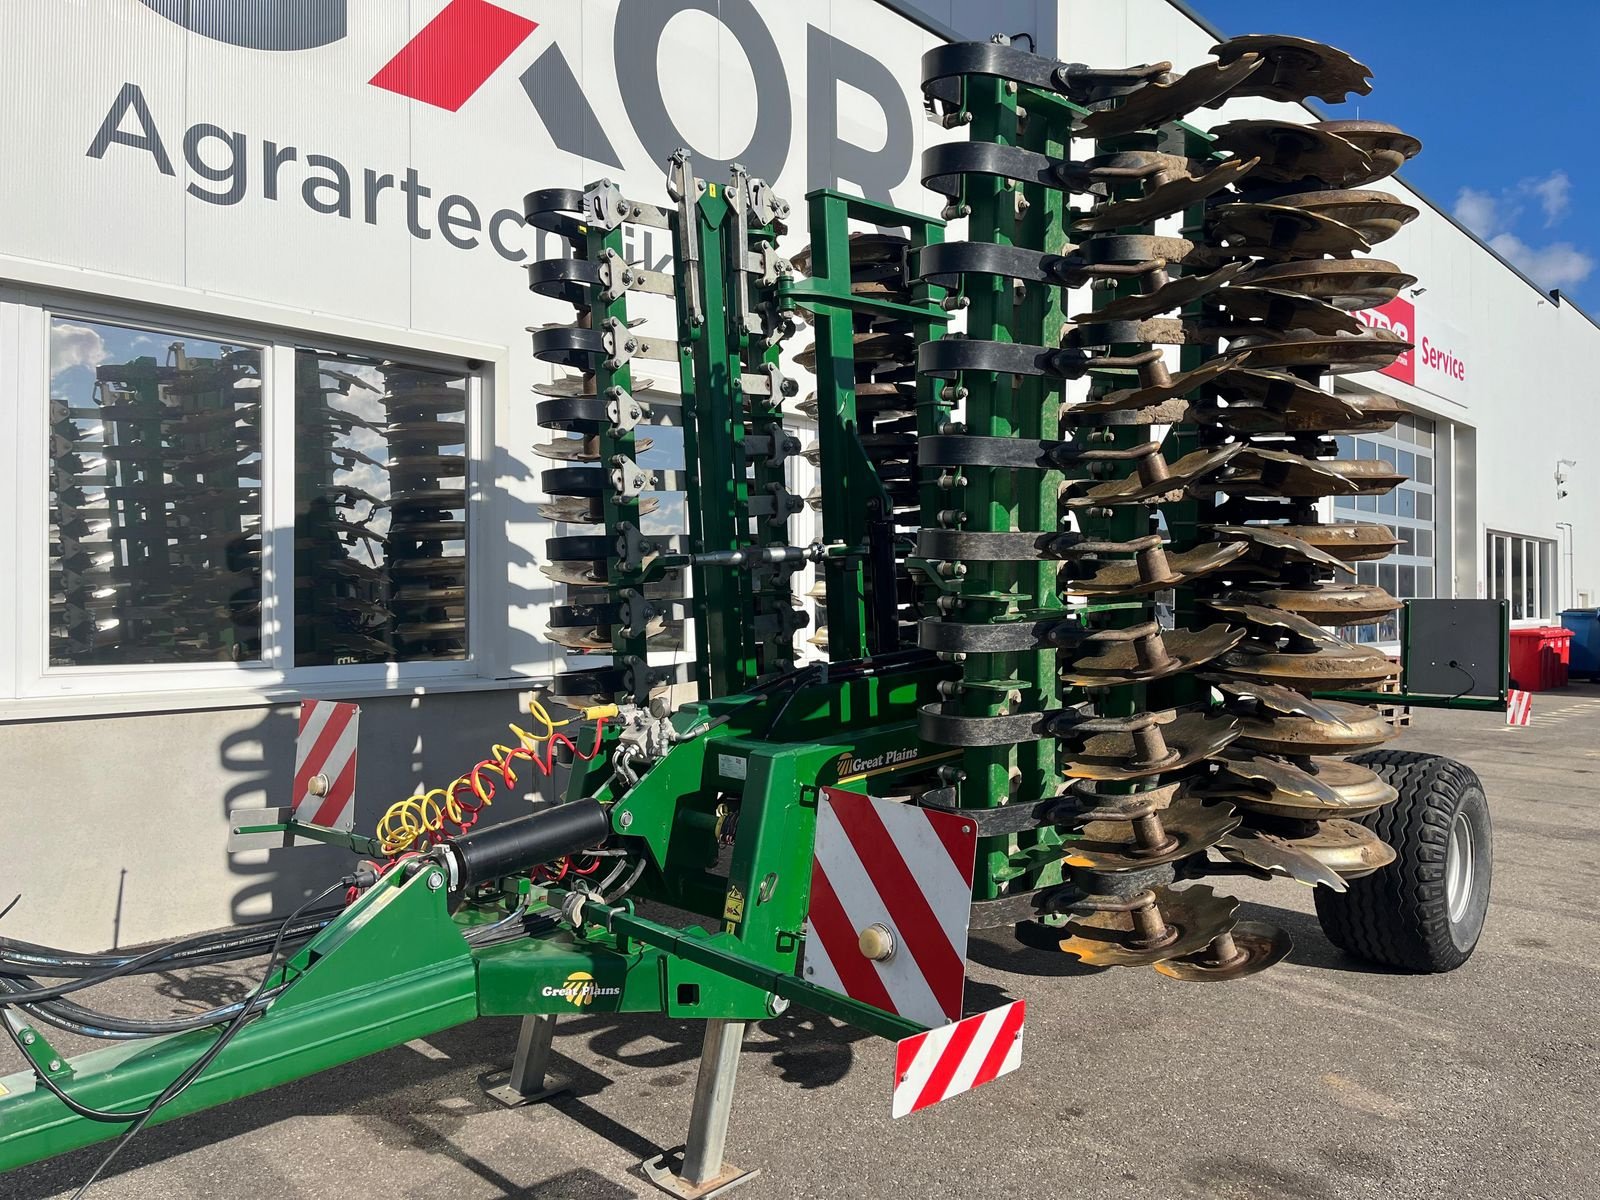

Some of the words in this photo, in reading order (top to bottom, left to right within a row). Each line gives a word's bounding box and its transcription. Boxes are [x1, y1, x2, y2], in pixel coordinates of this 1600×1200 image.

[1422, 337, 1465, 381] Service
[852, 756, 884, 772] Great
[886, 747, 918, 764] Plains
[542, 986, 578, 996] Great
[582, 985, 620, 995] Plains
